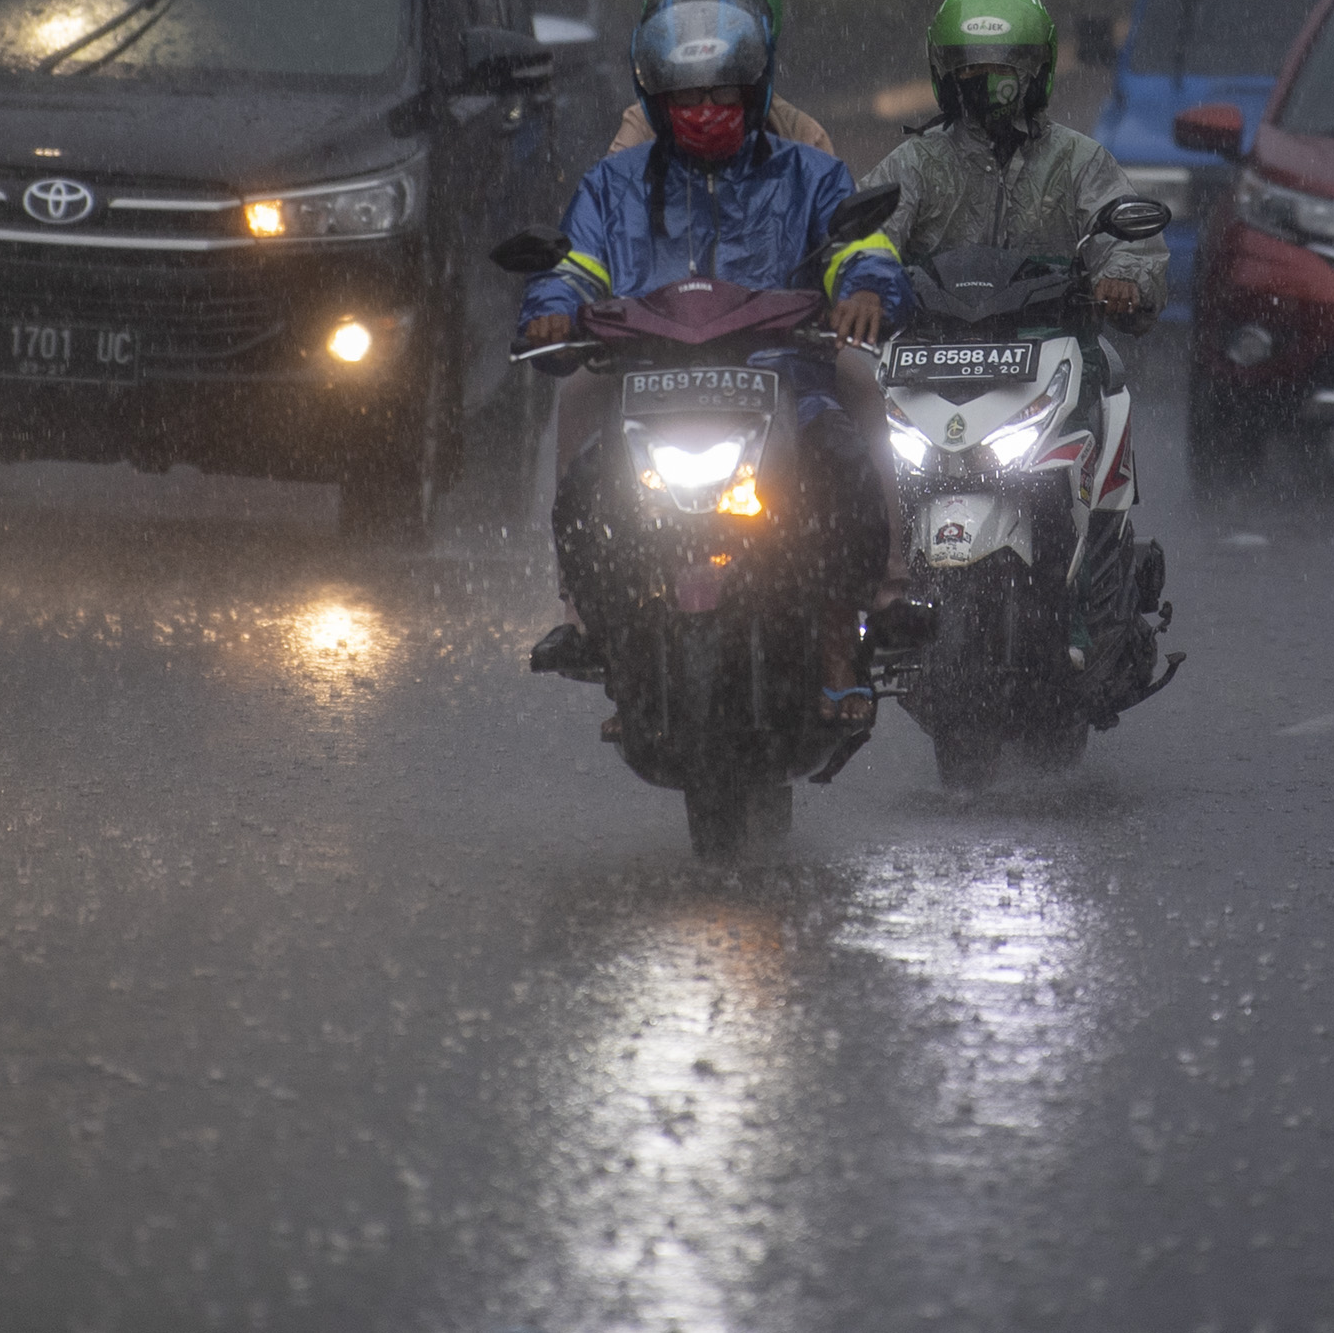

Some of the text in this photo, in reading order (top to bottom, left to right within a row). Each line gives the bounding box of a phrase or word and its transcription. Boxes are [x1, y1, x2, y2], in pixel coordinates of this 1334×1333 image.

[677, 281, 713, 294] YAMAHA
[12, 325, 71, 359] 1701
[97, 330, 134, 364] UC
[900, 348, 1026, 366] BG 6598 AAT
